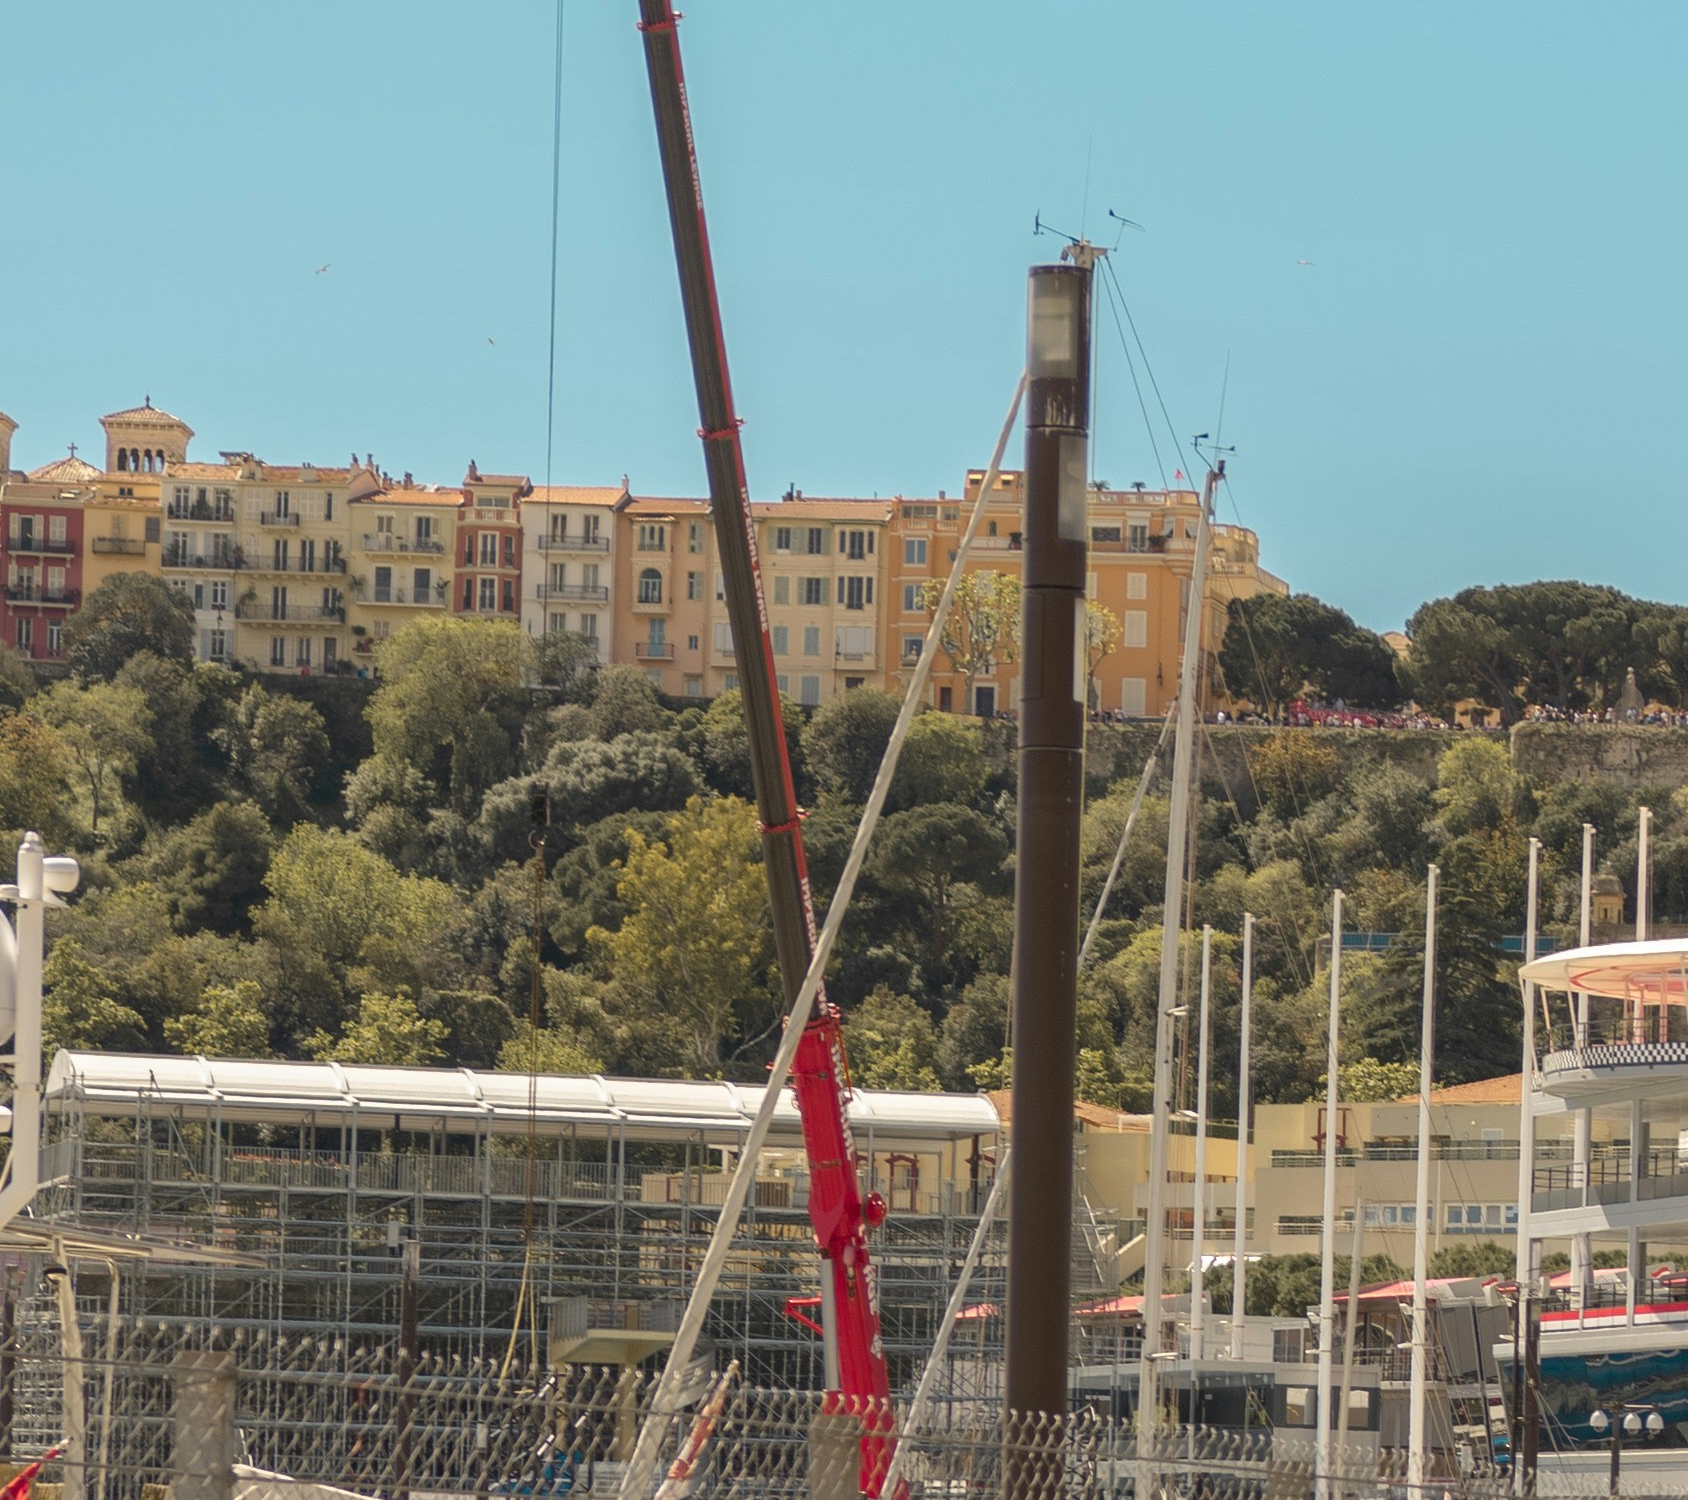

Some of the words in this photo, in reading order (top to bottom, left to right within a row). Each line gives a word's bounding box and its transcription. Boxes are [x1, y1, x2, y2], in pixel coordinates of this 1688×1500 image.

[679, 82, 694, 152] IMPERIAL
[690, 155, 703, 210] LEVAGE
[741, 486, 758, 567] IMPERIAL
[753, 570, 769, 633] LEVAGE
